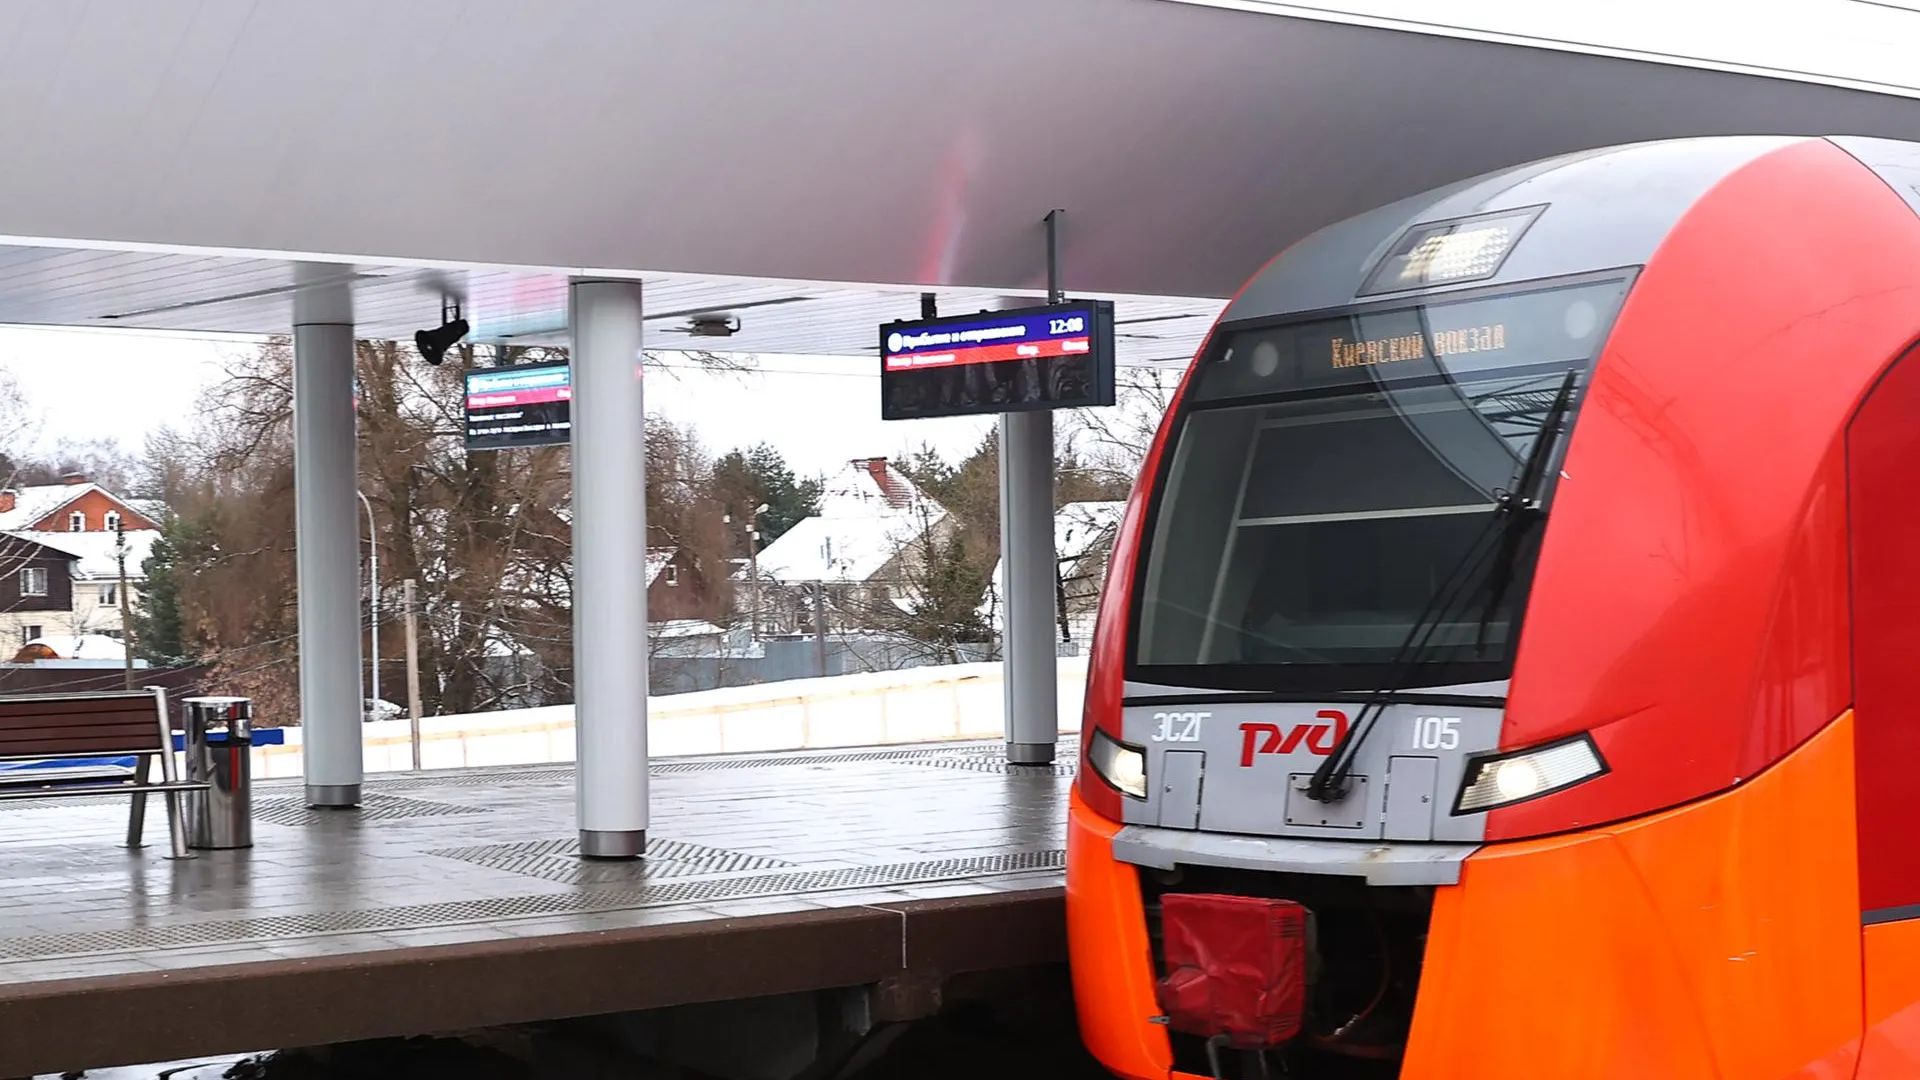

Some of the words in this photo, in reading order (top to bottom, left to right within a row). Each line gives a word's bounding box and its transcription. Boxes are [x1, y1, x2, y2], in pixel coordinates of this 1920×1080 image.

[1332, 332, 1424, 368] Киевский
[1433, 324, 1505, 356] вокзал
[1413, 716, 1461, 750] 105
